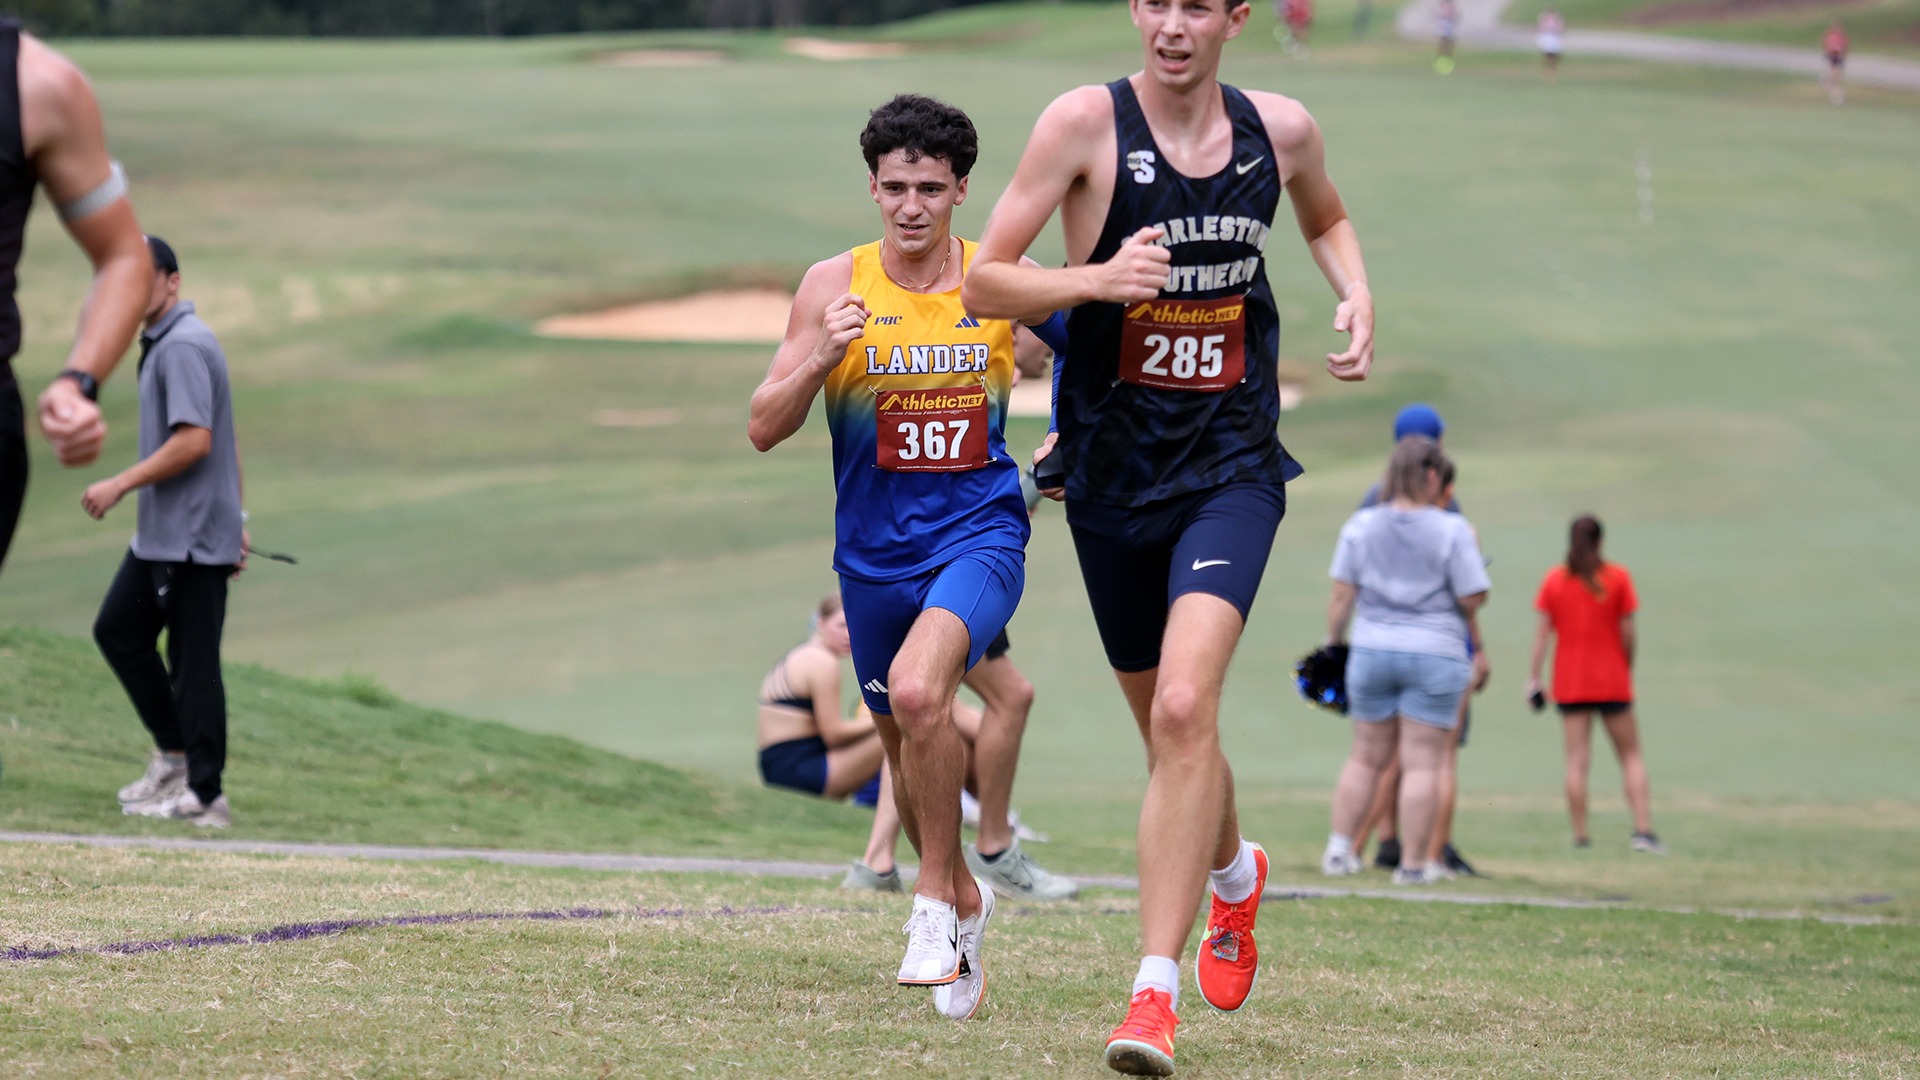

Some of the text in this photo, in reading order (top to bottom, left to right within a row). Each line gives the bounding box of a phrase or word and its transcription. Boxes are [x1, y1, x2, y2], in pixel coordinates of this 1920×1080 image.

[1121, 215, 1270, 251] ARLESTON
[1163, 256, 1259, 292] UTHERN
[874, 316, 902, 325] PBC
[866, 344, 989, 375] LANDER
[1142, 334, 1225, 379] 285
[898, 420, 970, 460] 367
